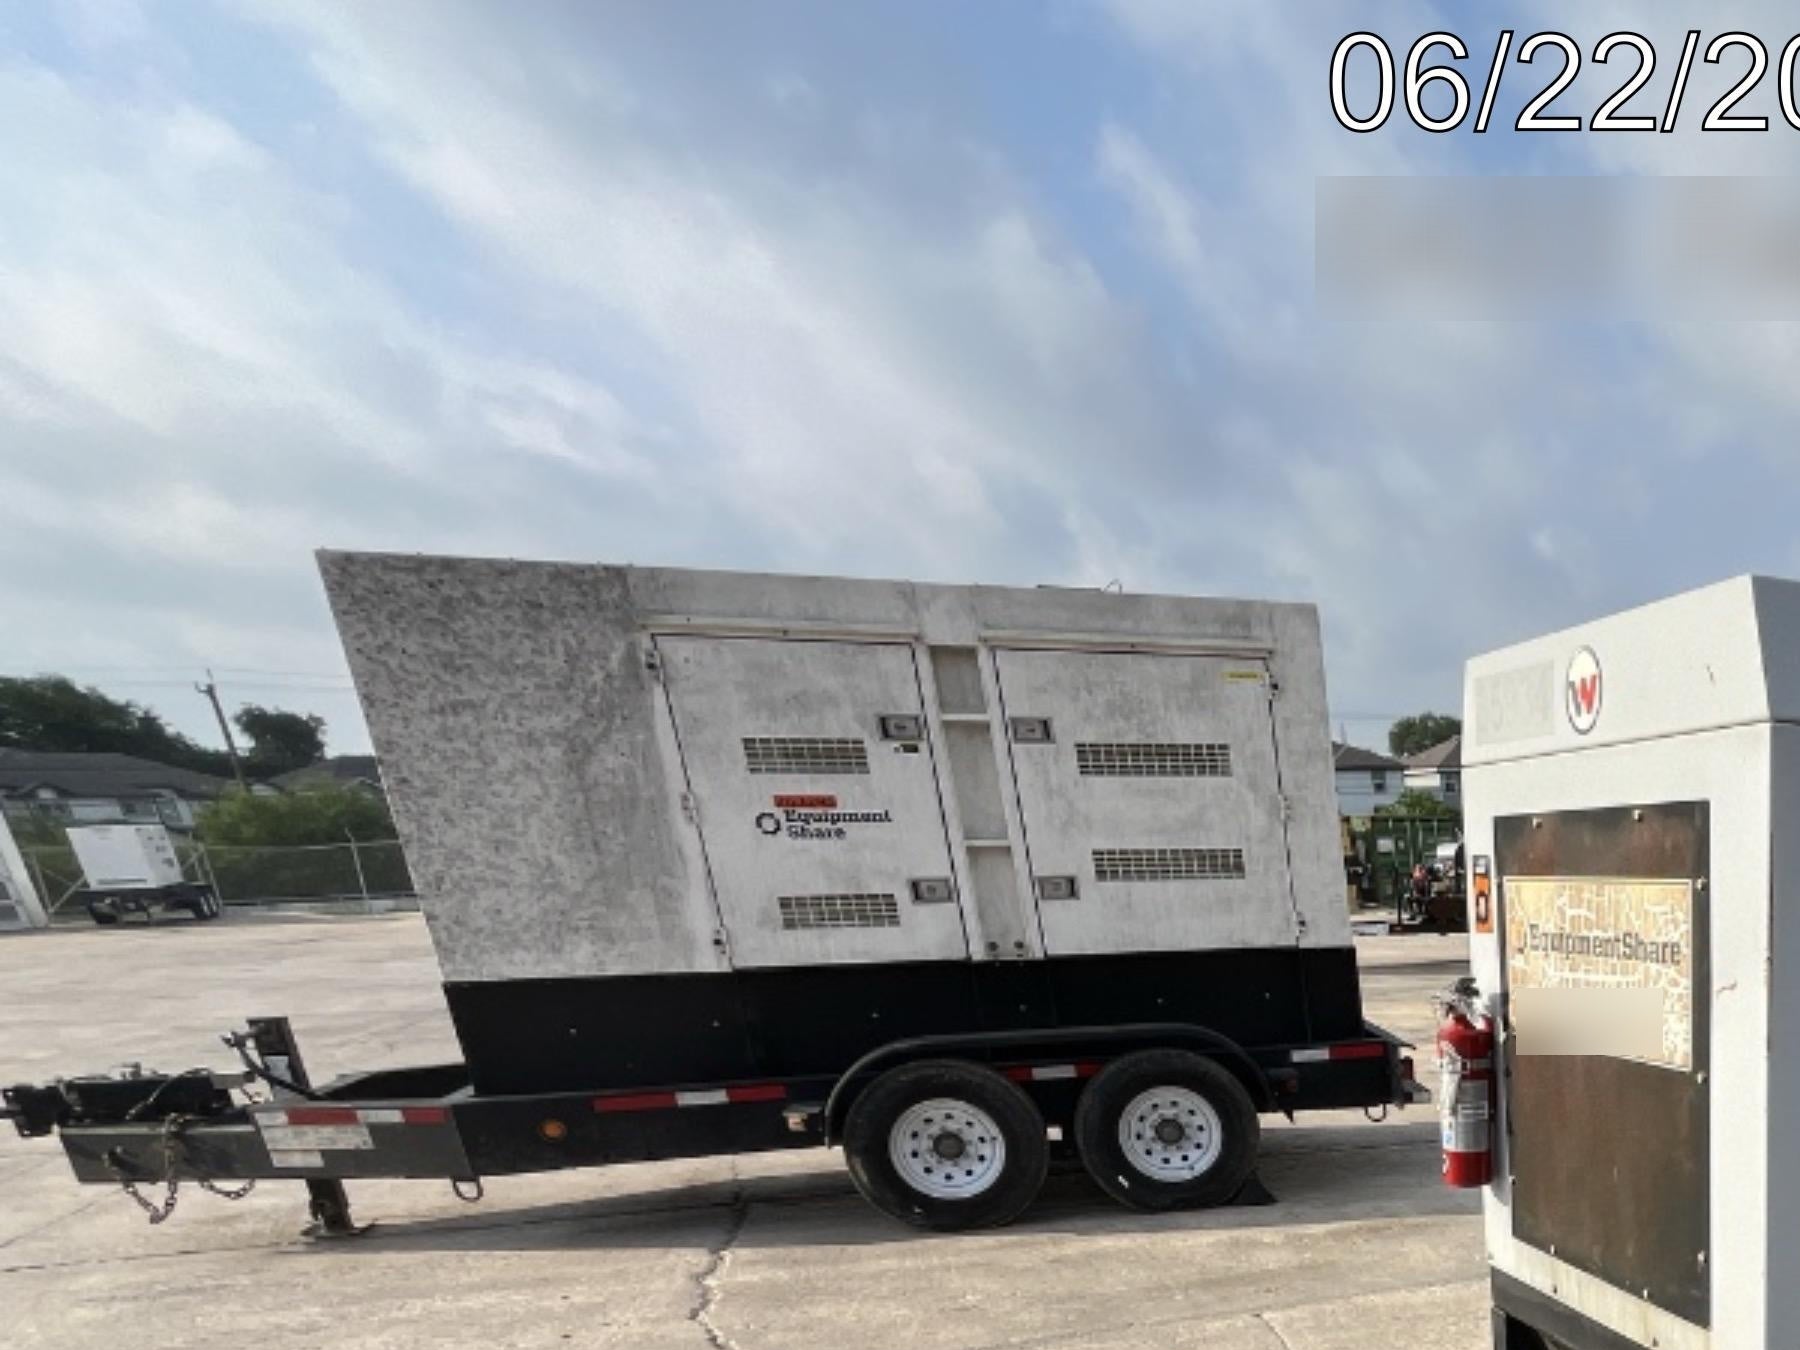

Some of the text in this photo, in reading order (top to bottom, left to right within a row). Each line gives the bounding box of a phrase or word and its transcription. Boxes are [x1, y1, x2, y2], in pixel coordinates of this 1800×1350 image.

[783, 809, 892, 825] Equipment
[786, 825, 847, 840] Share
[1528, 923, 1682, 966] EquipmentShare
